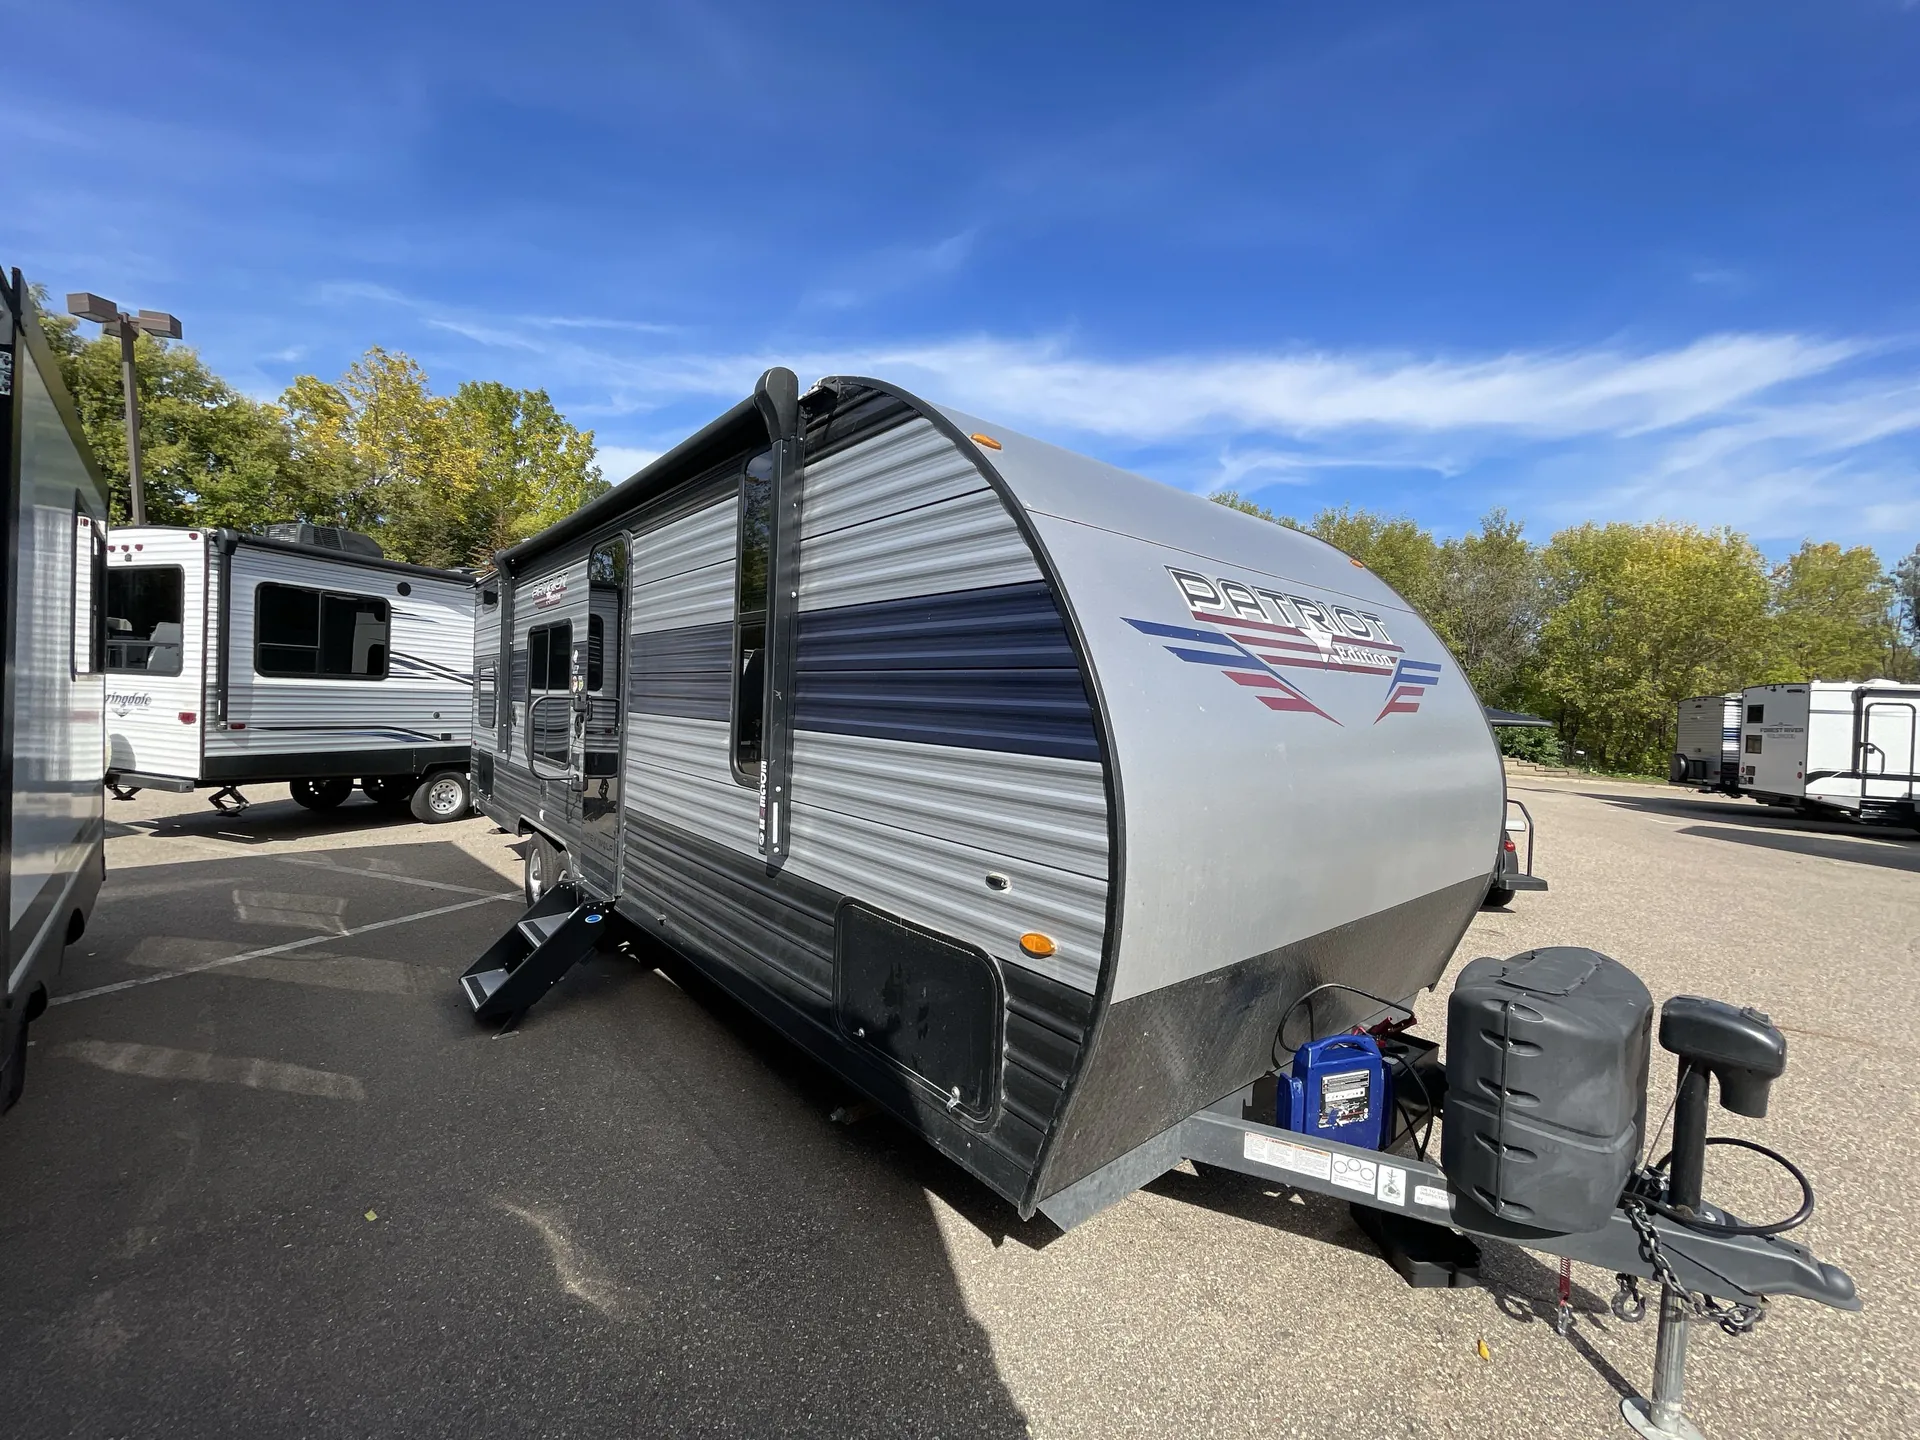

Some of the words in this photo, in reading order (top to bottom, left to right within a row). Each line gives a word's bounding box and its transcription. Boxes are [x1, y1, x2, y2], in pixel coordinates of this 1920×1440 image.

[1163, 565, 1395, 645] PATRIOT
[1335, 644, 1394, 667] Edition
[105, 692, 153, 708] ringdale
